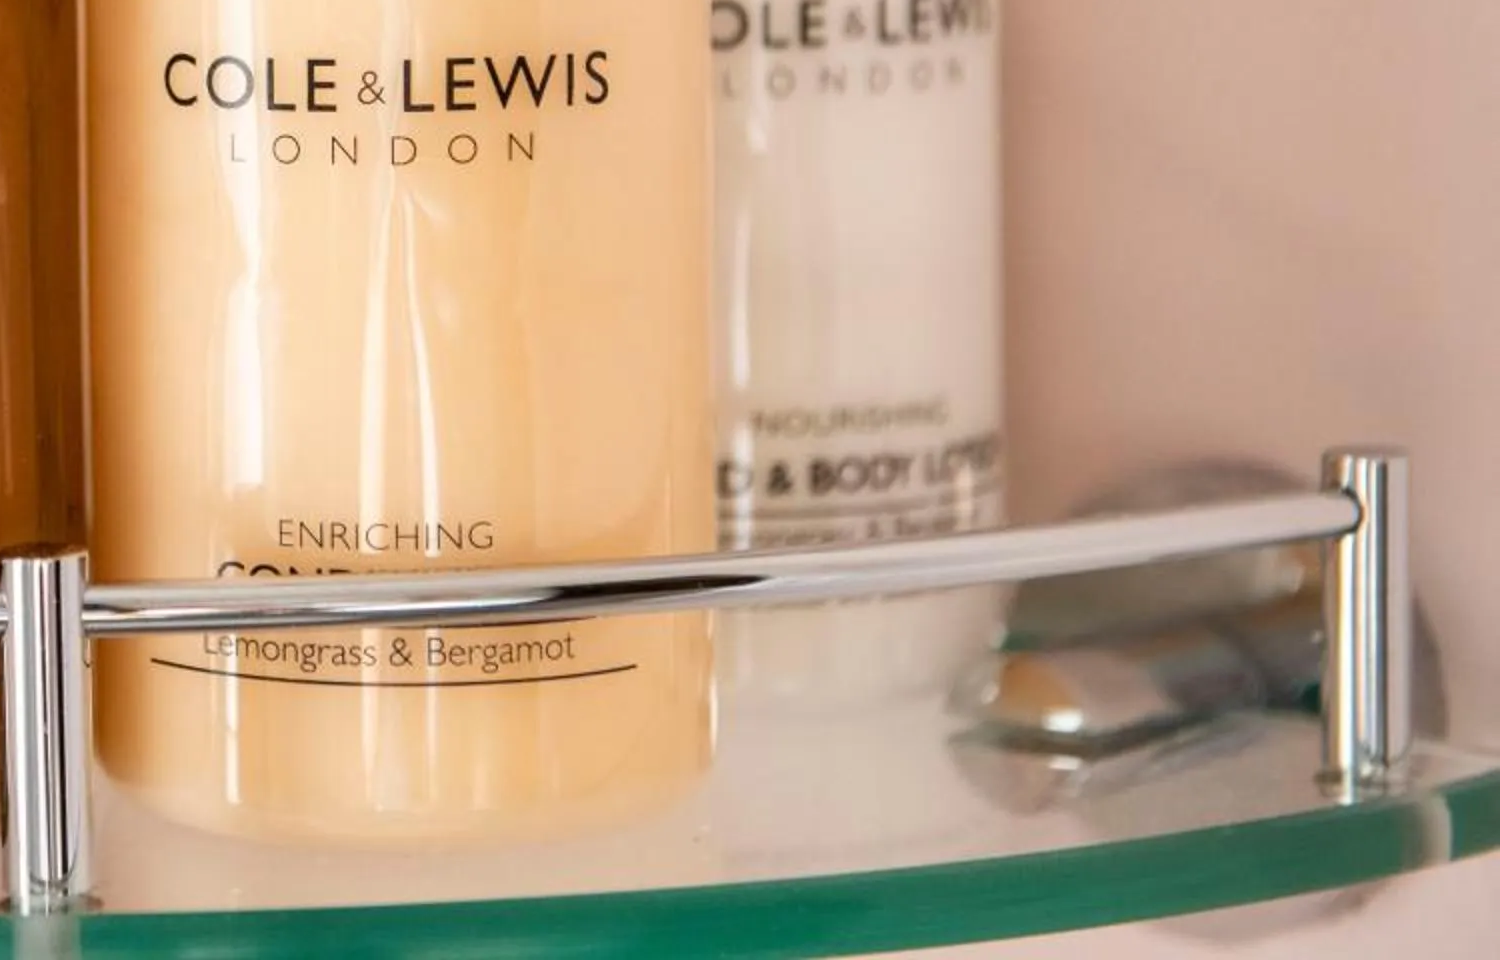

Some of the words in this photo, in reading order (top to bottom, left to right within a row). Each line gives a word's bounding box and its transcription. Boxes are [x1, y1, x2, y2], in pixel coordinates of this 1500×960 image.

[164, 52, 337, 113] COLE
[357, 70, 386, 105] &
[402, 50, 610, 113] LEWIS
[230, 131, 535, 166] LONDON
[809, 451, 915, 495] BODY
[278, 519, 494, 551] ENRICHING
[203, 633, 377, 673] Lemongrass
[389, 637, 413, 667] &
[427, 633, 576, 673] Bergamot
